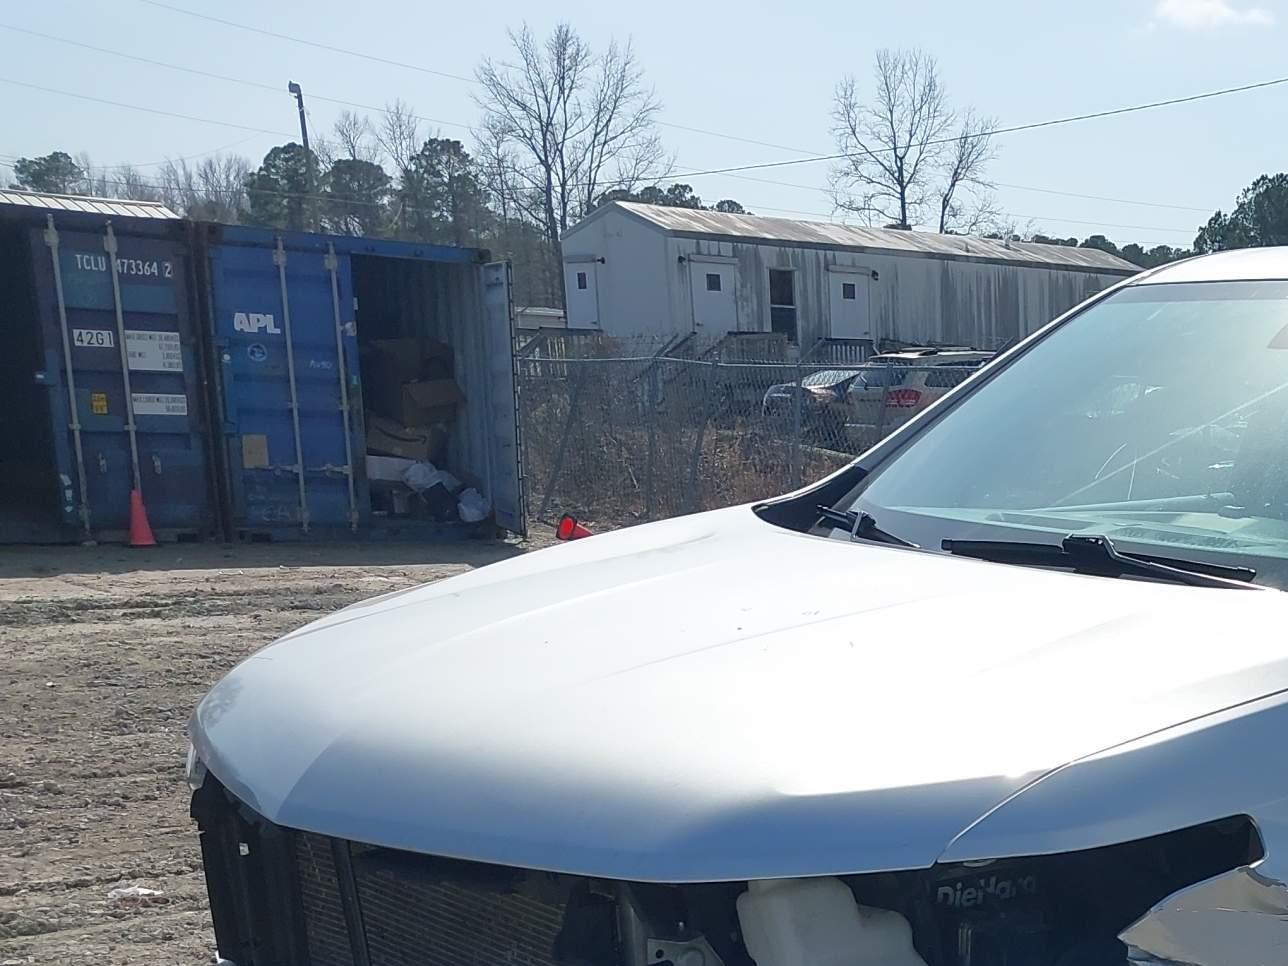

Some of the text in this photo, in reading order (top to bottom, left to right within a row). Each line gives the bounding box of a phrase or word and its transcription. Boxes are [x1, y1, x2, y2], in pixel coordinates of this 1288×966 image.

[75, 254, 107, 271] TCLU
[165, 263, 172, 278] 2
[233, 312, 281, 334] APL
[75, 331, 113, 346] 42G1
